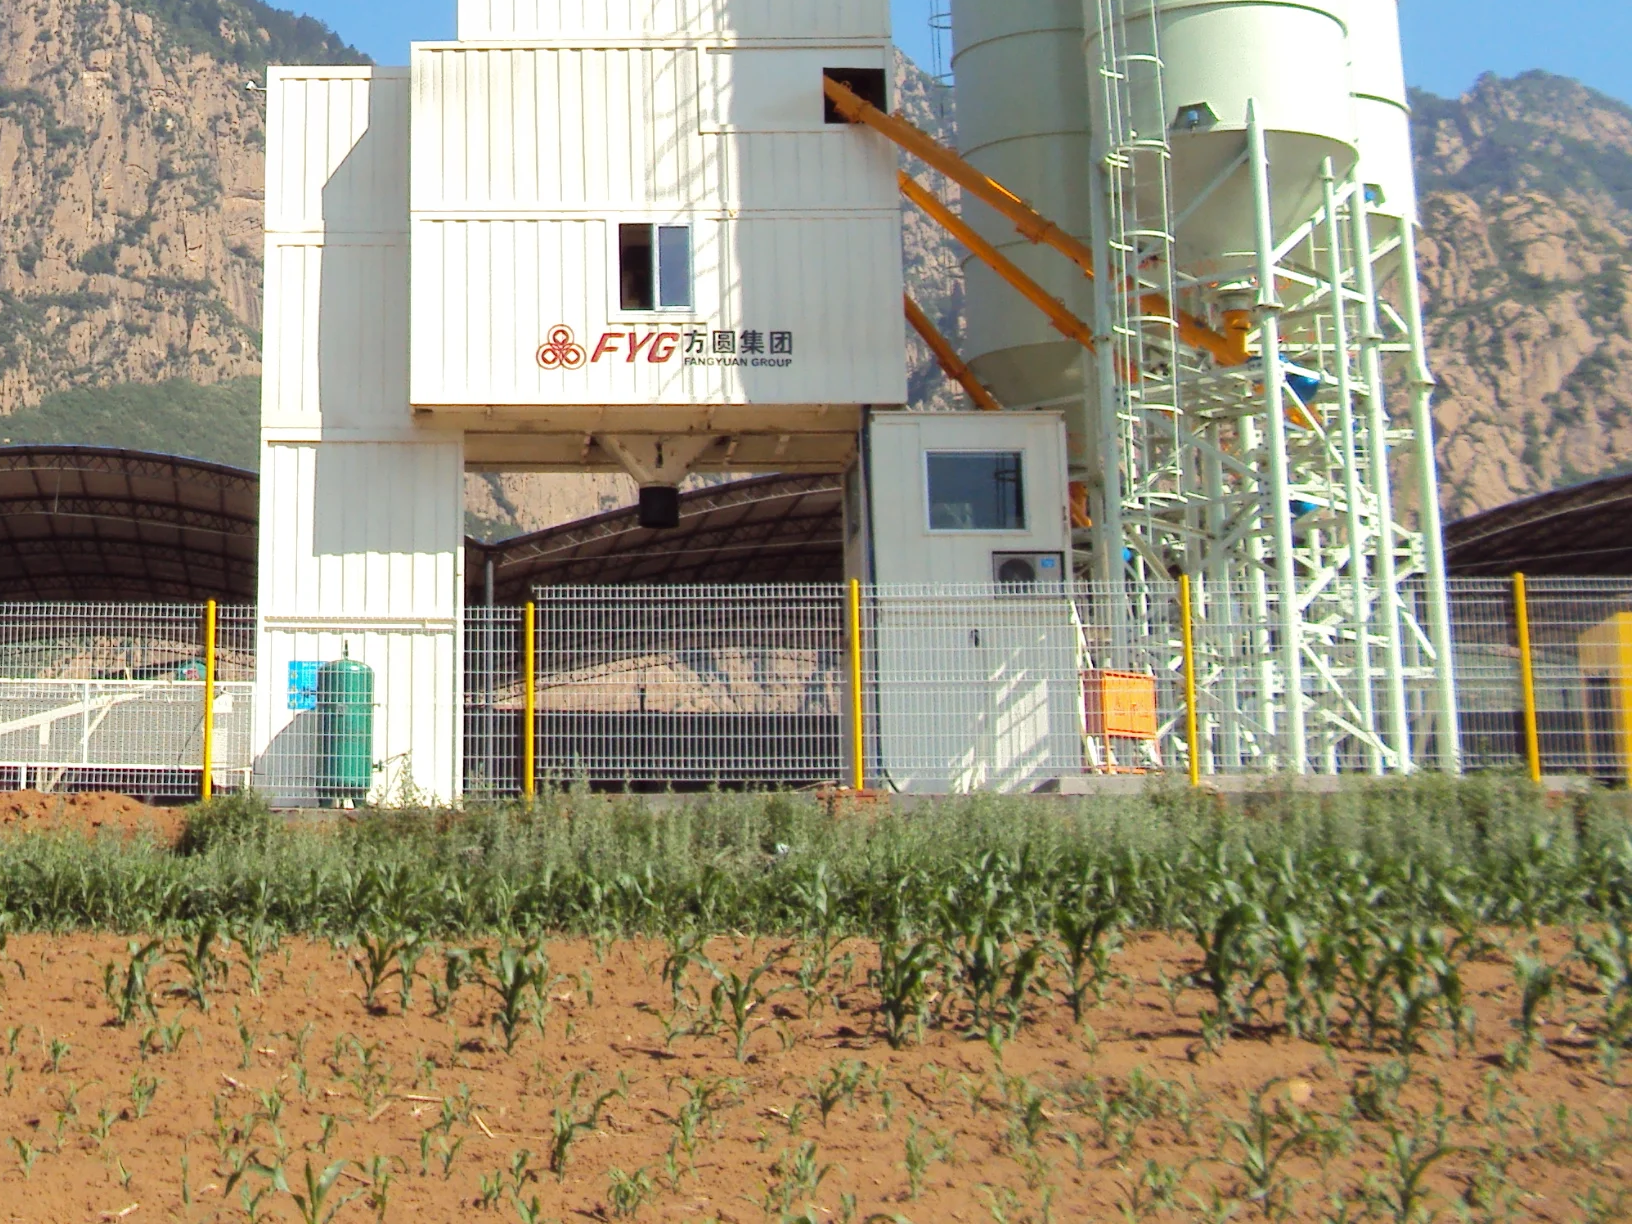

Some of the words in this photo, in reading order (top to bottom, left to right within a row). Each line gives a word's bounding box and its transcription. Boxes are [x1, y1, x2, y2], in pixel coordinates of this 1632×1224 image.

[590, 332, 680, 363] FYG
[683, 330, 793, 355] 方圆集团
[684, 357, 748, 367] FANGYUAN
[751, 358, 792, 367] GROUP
